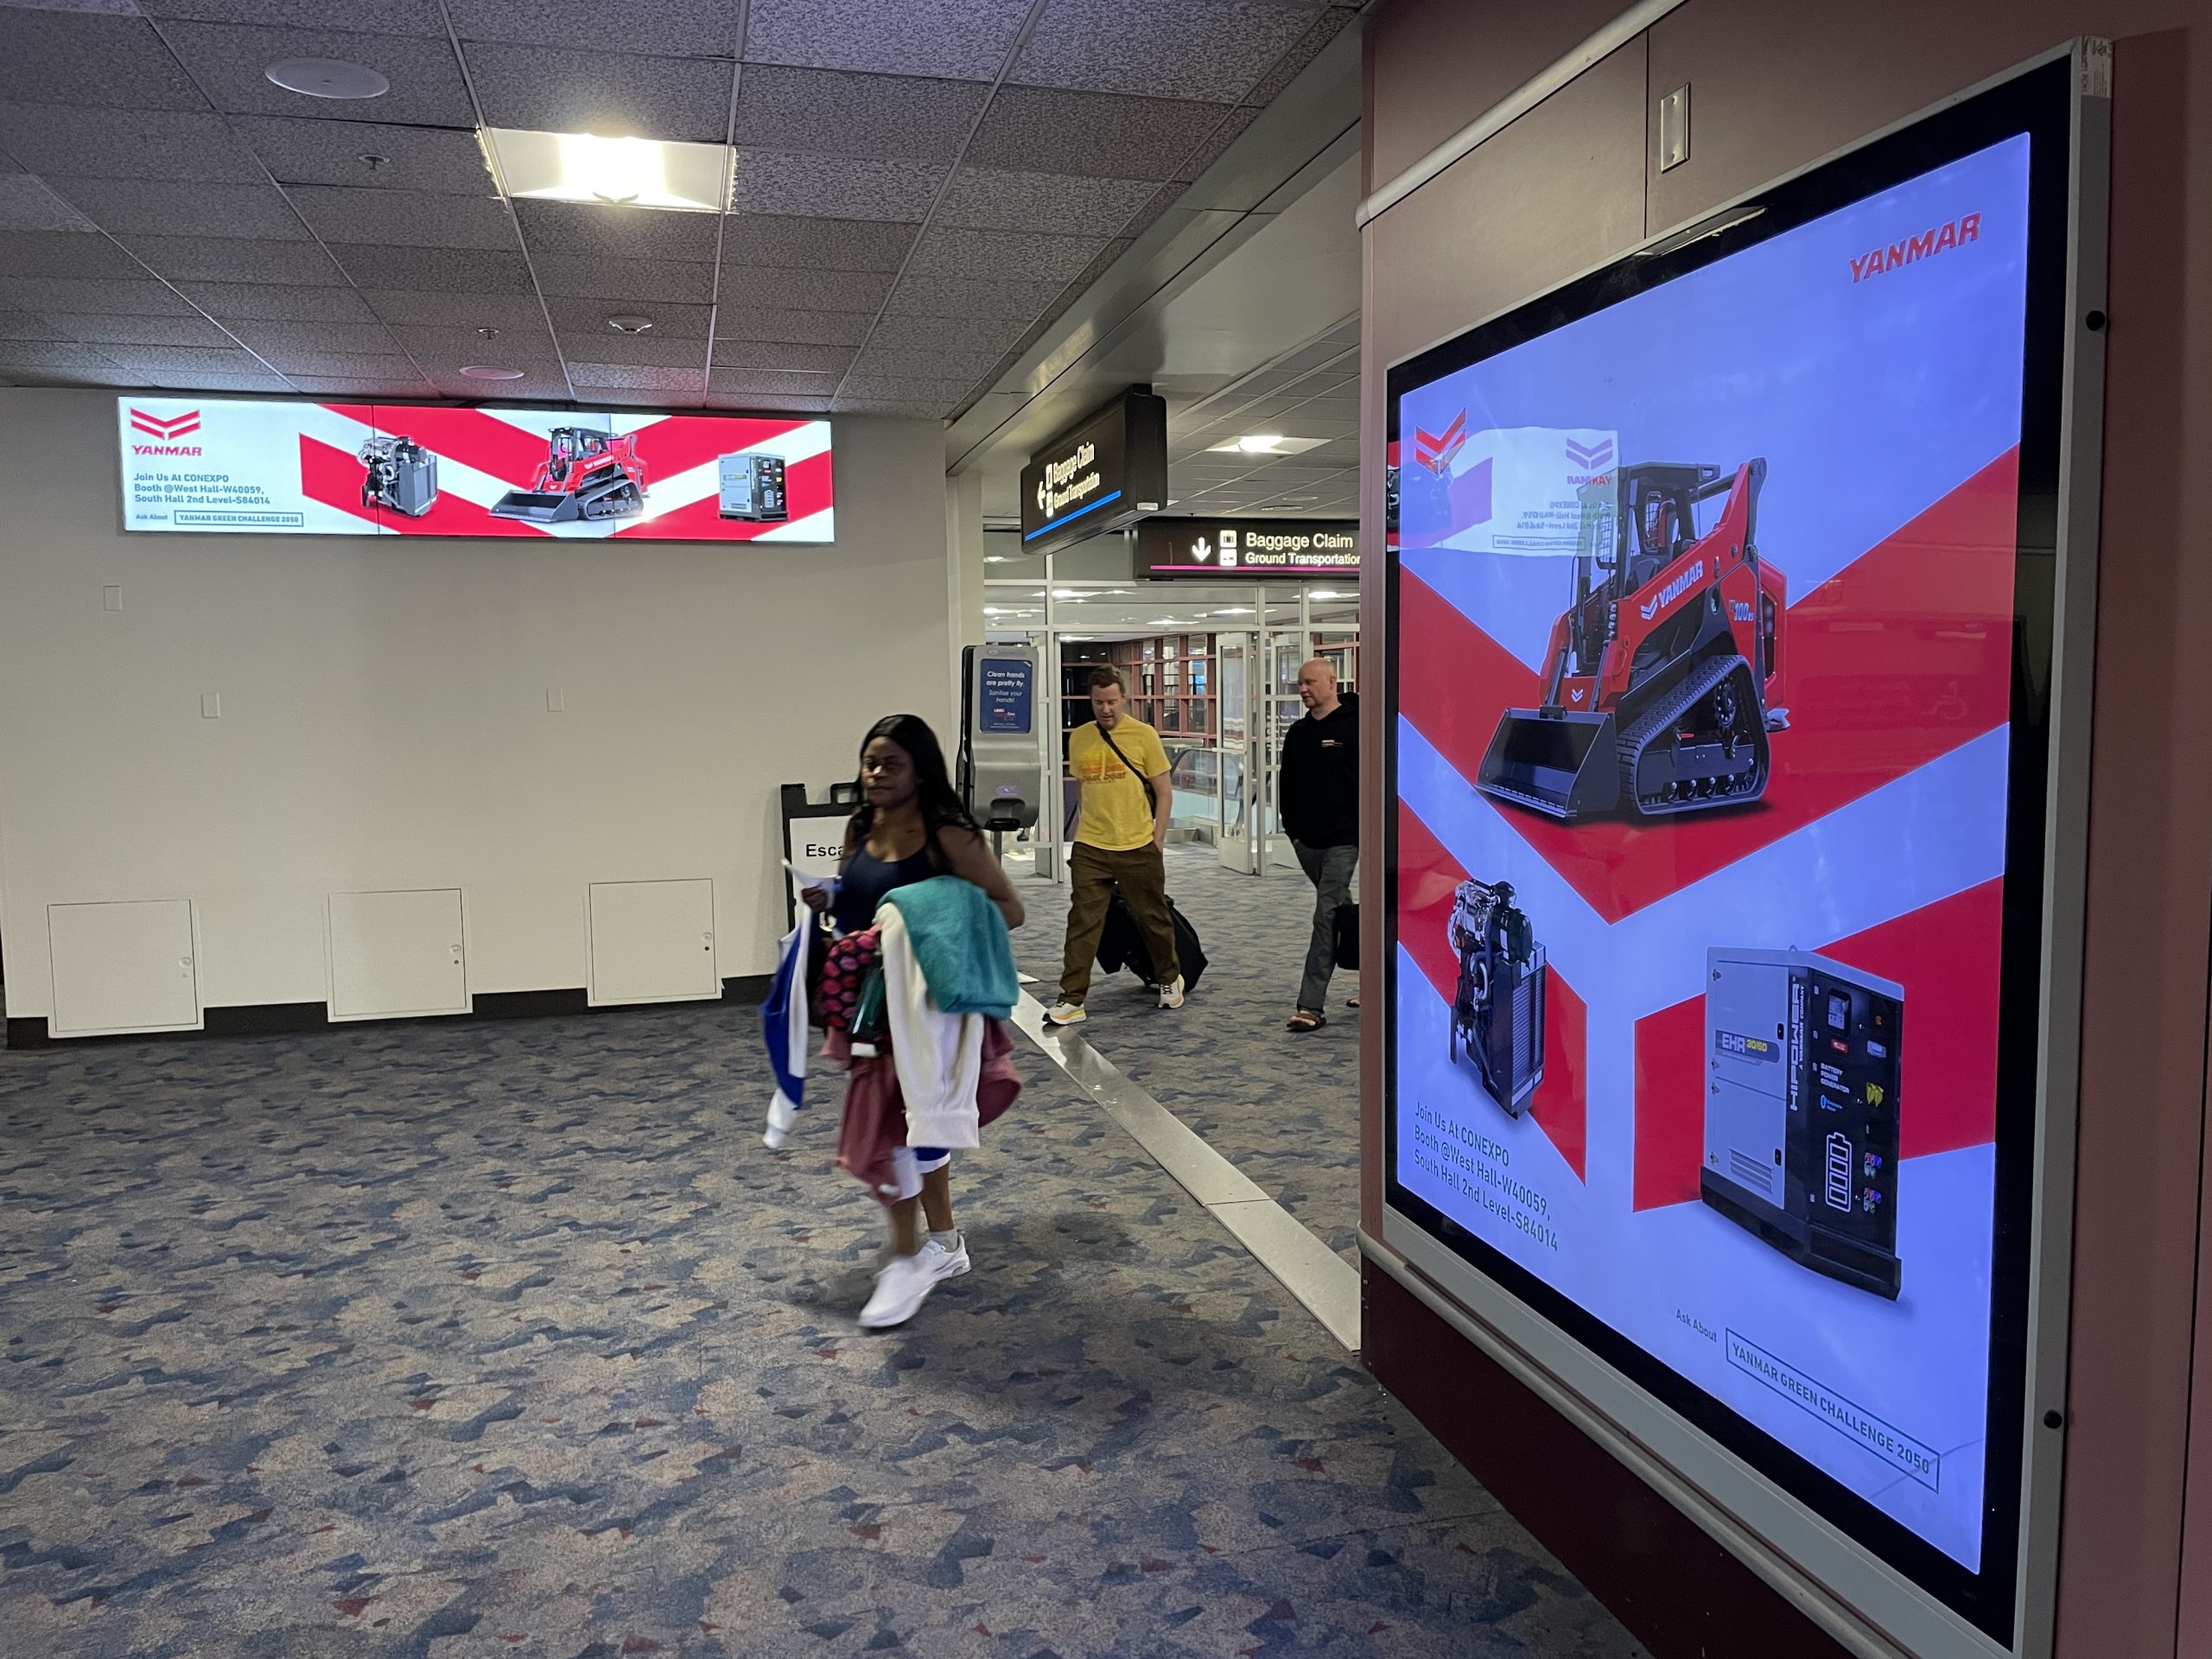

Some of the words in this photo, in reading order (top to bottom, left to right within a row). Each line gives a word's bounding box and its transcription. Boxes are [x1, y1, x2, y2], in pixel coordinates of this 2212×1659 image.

[1849, 212, 1981, 283] YANMAR
[132, 445, 202, 456] YANMAR
[134, 484, 162, 493] Booth
[164, 485, 198, 493] @West
[156, 474, 168, 482] Us
[184, 474, 229, 483] CONEXPO
[135, 494, 162, 503] South
[165, 495, 184, 504] Hall
[187, 495, 204, 504] 2nd
[207, 496, 270, 505] Level-S84014
[1246, 531, 1310, 550] Baggage
[1313, 533, 1353, 548] Claim
[1245, 552, 1286, 564] Ground
[1658, 560, 1703, 608] YANMAR
[1722, 1033, 1745, 1053] EHR
[1790, 983, 1800, 1111] HIPOWER
[1414, 1102, 1433, 1124] Join
[1434, 1111, 1446, 1132] Us
[1448, 1120, 1459, 1140] At
[1461, 1127, 1510, 1167] CONEXPO
[1414, 1125, 1439, 1153] Booth
[1440, 1141, 1474, 1172] @West
[1477, 1162, 1551, 1221] Hall-W40059,
[1414, 1149, 1439, 1177] South
[1441, 1165, 1459, 1192] Hall
[1462, 1179, 1479, 1204] 2nd
[1483, 1190, 1558, 1252] Level-S84014
[1676, 1309, 1691, 1327] Ask
[1693, 1319, 1717, 1343] About
[1732, 1342, 1778, 1382] YANMAR
[1780, 1373, 1818, 1407] GREEN
[1820, 1397, 1894, 1453] CHALLENGE
[1897, 1443, 1930, 1475] 2050
